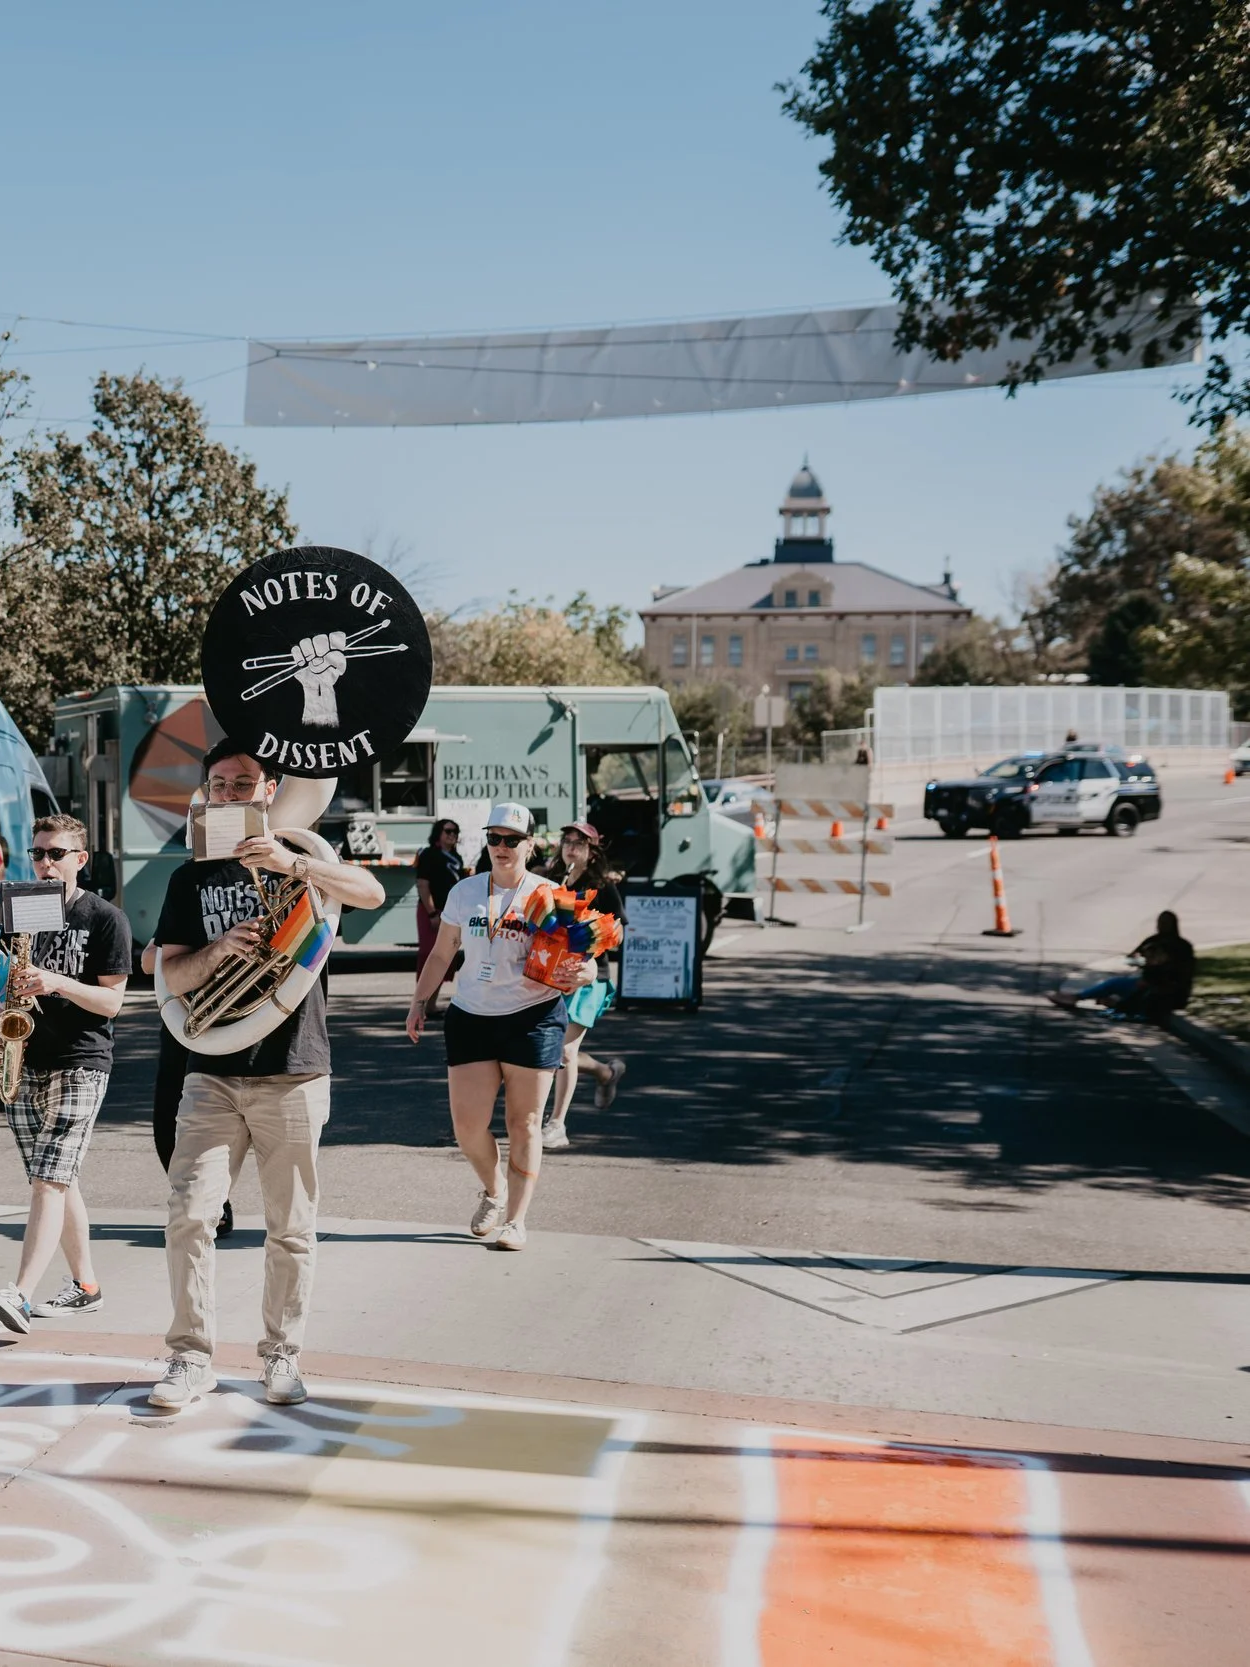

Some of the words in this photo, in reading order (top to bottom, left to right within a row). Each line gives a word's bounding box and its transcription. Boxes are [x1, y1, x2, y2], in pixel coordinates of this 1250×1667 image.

[239, 571, 338, 617] NOTES
[350, 582, 393, 616] OF
[255, 729, 375, 769] DISSENT
[443, 783, 499, 799] FOOD
[504, 782, 570, 798] TRUCK
[200, 880, 263, 917] NOTES
[637, 899, 686, 908] TACOS
[468, 917, 488, 928] BIG
